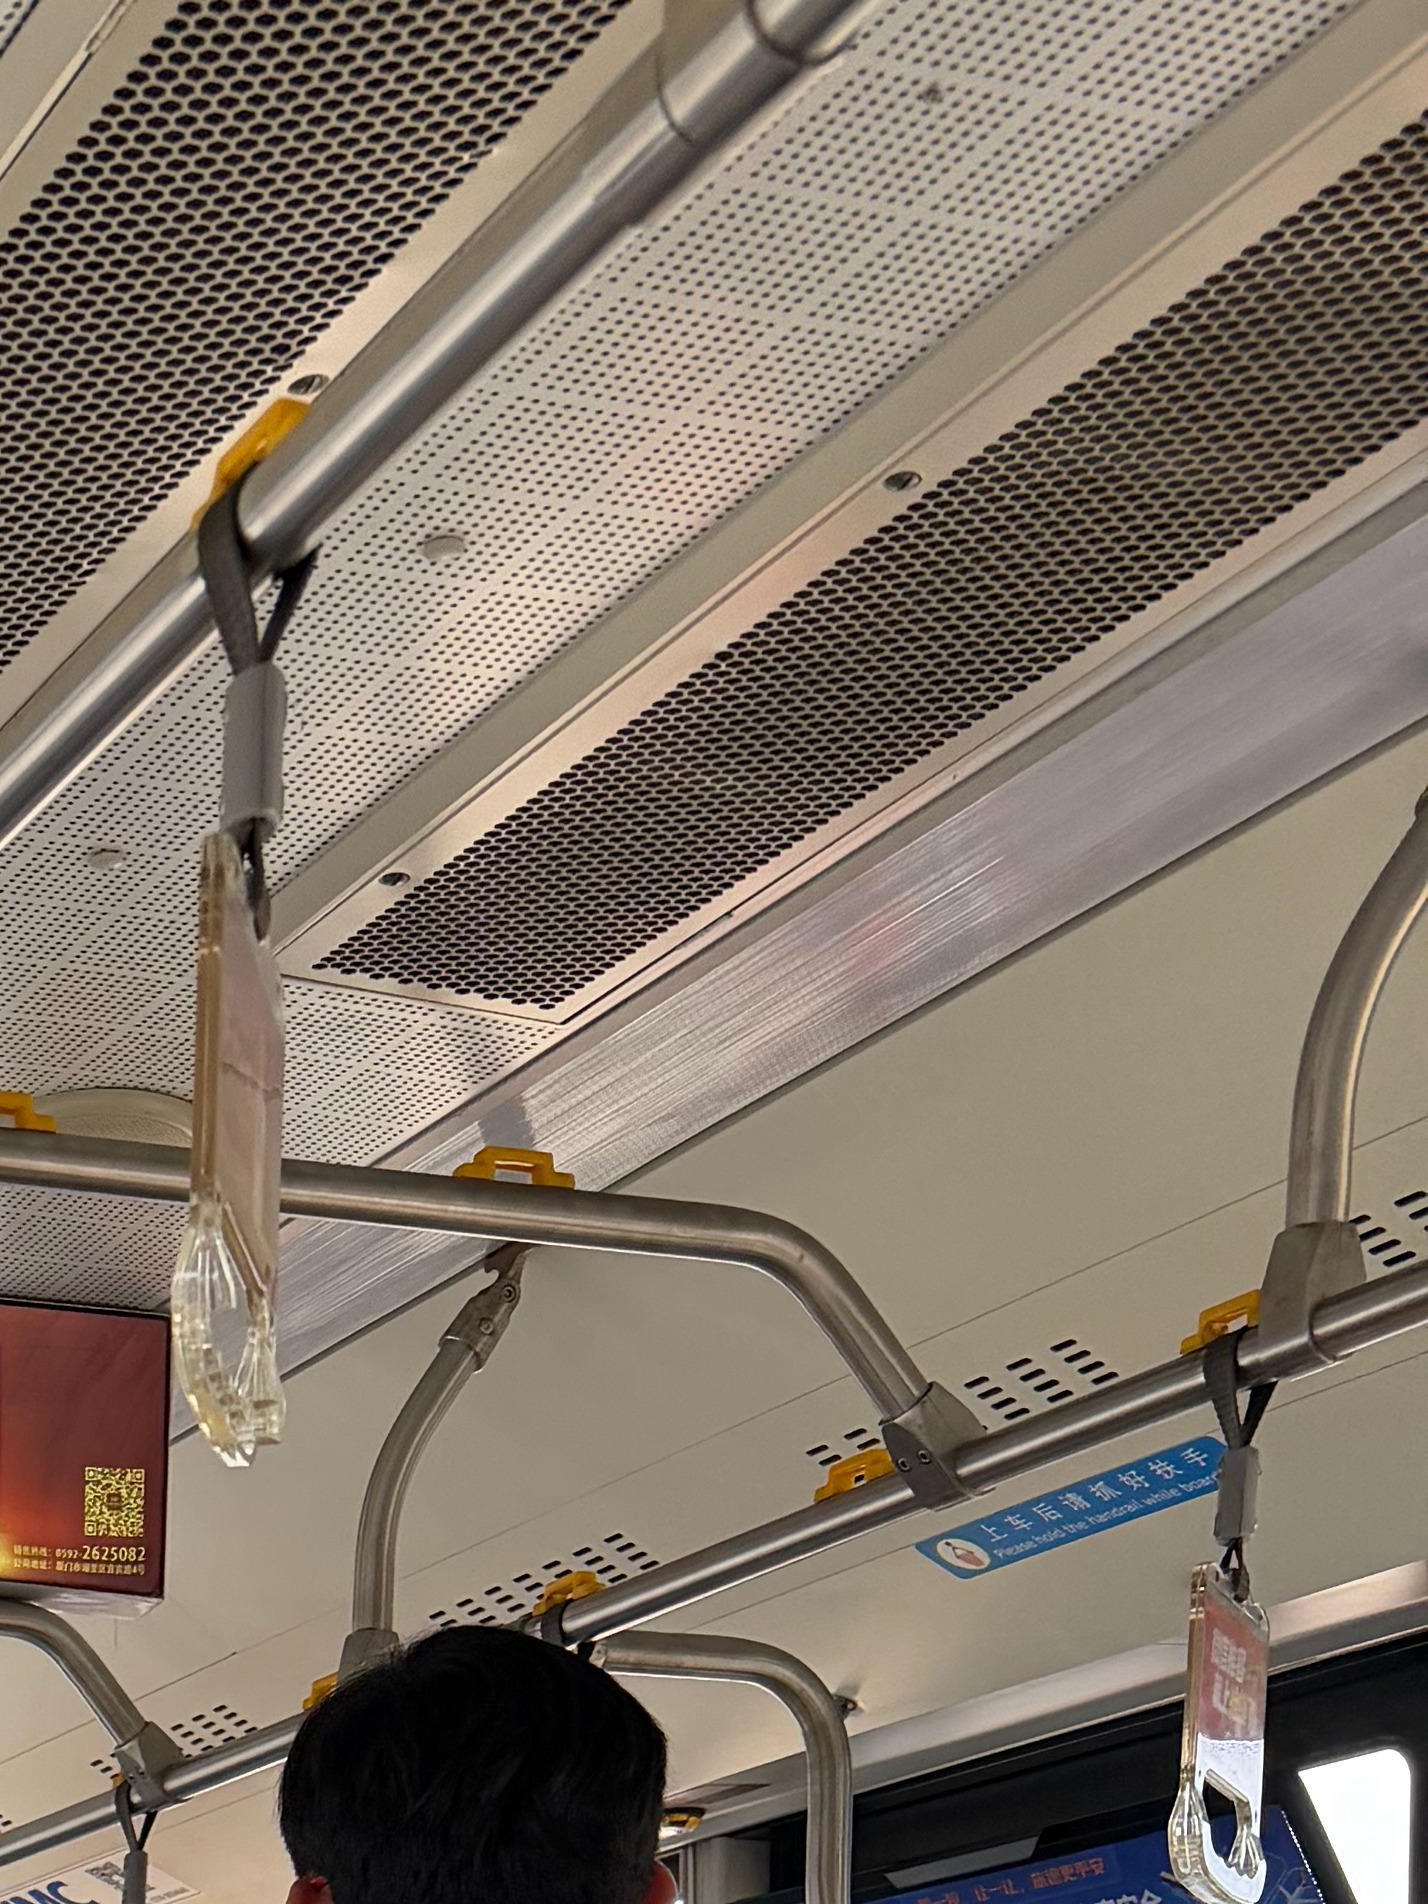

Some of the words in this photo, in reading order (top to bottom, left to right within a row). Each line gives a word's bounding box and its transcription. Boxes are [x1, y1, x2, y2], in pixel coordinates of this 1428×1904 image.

[980, 1448, 1208, 1542] 上车后请抓好扶手
[1090, 1499, 1144, 1526] handrail
[1143, 1487, 1182, 1506] while
